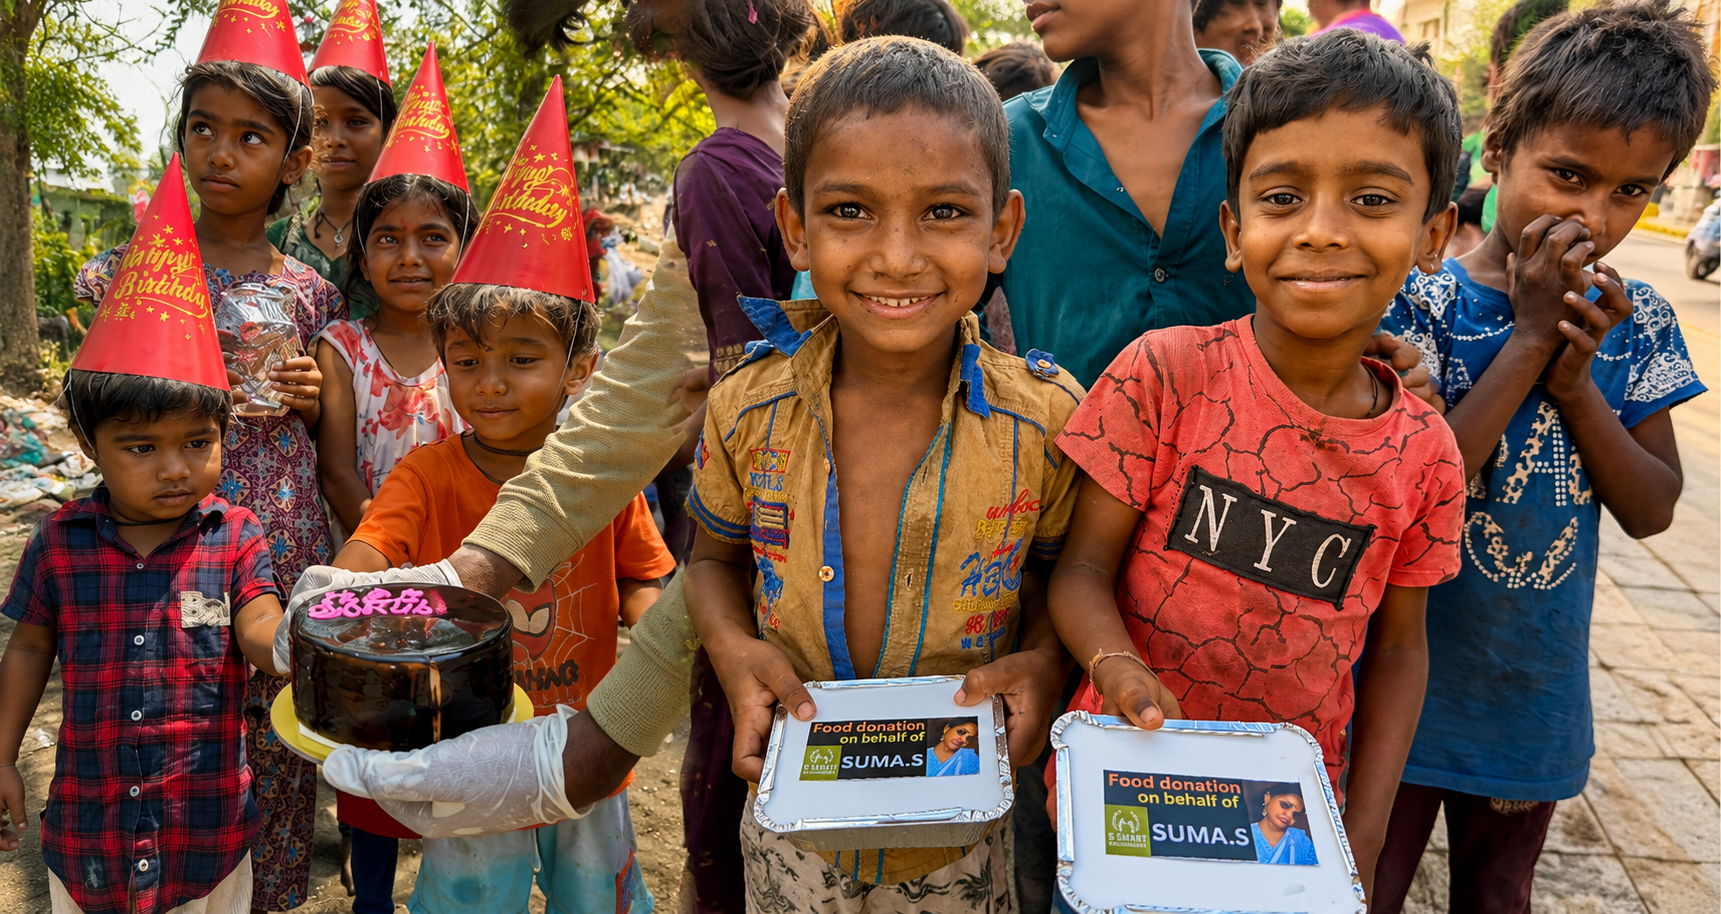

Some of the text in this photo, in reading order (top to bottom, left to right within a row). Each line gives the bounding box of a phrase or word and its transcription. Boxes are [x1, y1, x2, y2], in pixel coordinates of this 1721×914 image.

[1184, 484, 1352, 589] NYC
[813, 720, 926, 734] Food donation
[839, 731, 926, 745] on behalf of
[841, 752, 925, 769] SUMA.S
[1107, 772, 1242, 794] Food donation
[1137, 791, 1240, 809] on behalf of
[1151, 822, 1251, 847] SUMA.S
